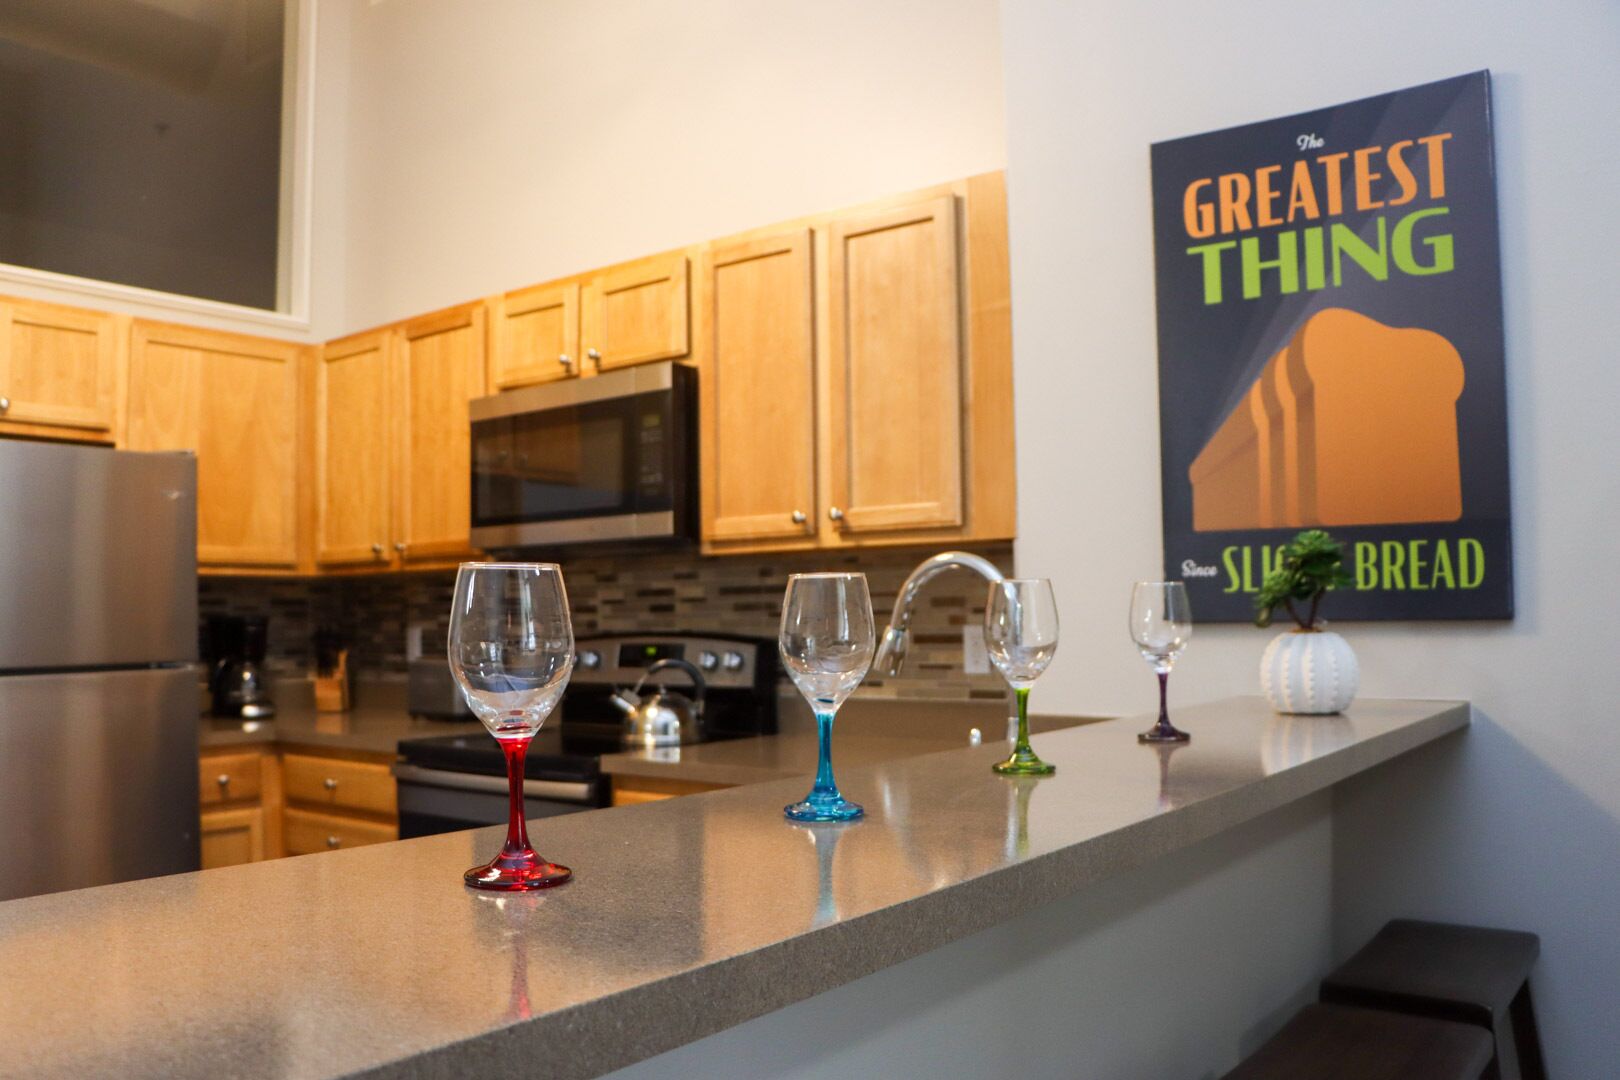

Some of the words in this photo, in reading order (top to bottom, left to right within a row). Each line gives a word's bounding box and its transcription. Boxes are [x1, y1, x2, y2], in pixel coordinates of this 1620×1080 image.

[1296, 133, 1325, 151] The
[1183, 132, 1453, 239] GREATEST
[1186, 206, 1455, 305] THING
[1181, 559, 1218, 577] Since
[1222, 545, 1336, 593] SLI
[1355, 538, 1485, 591] BREAD
